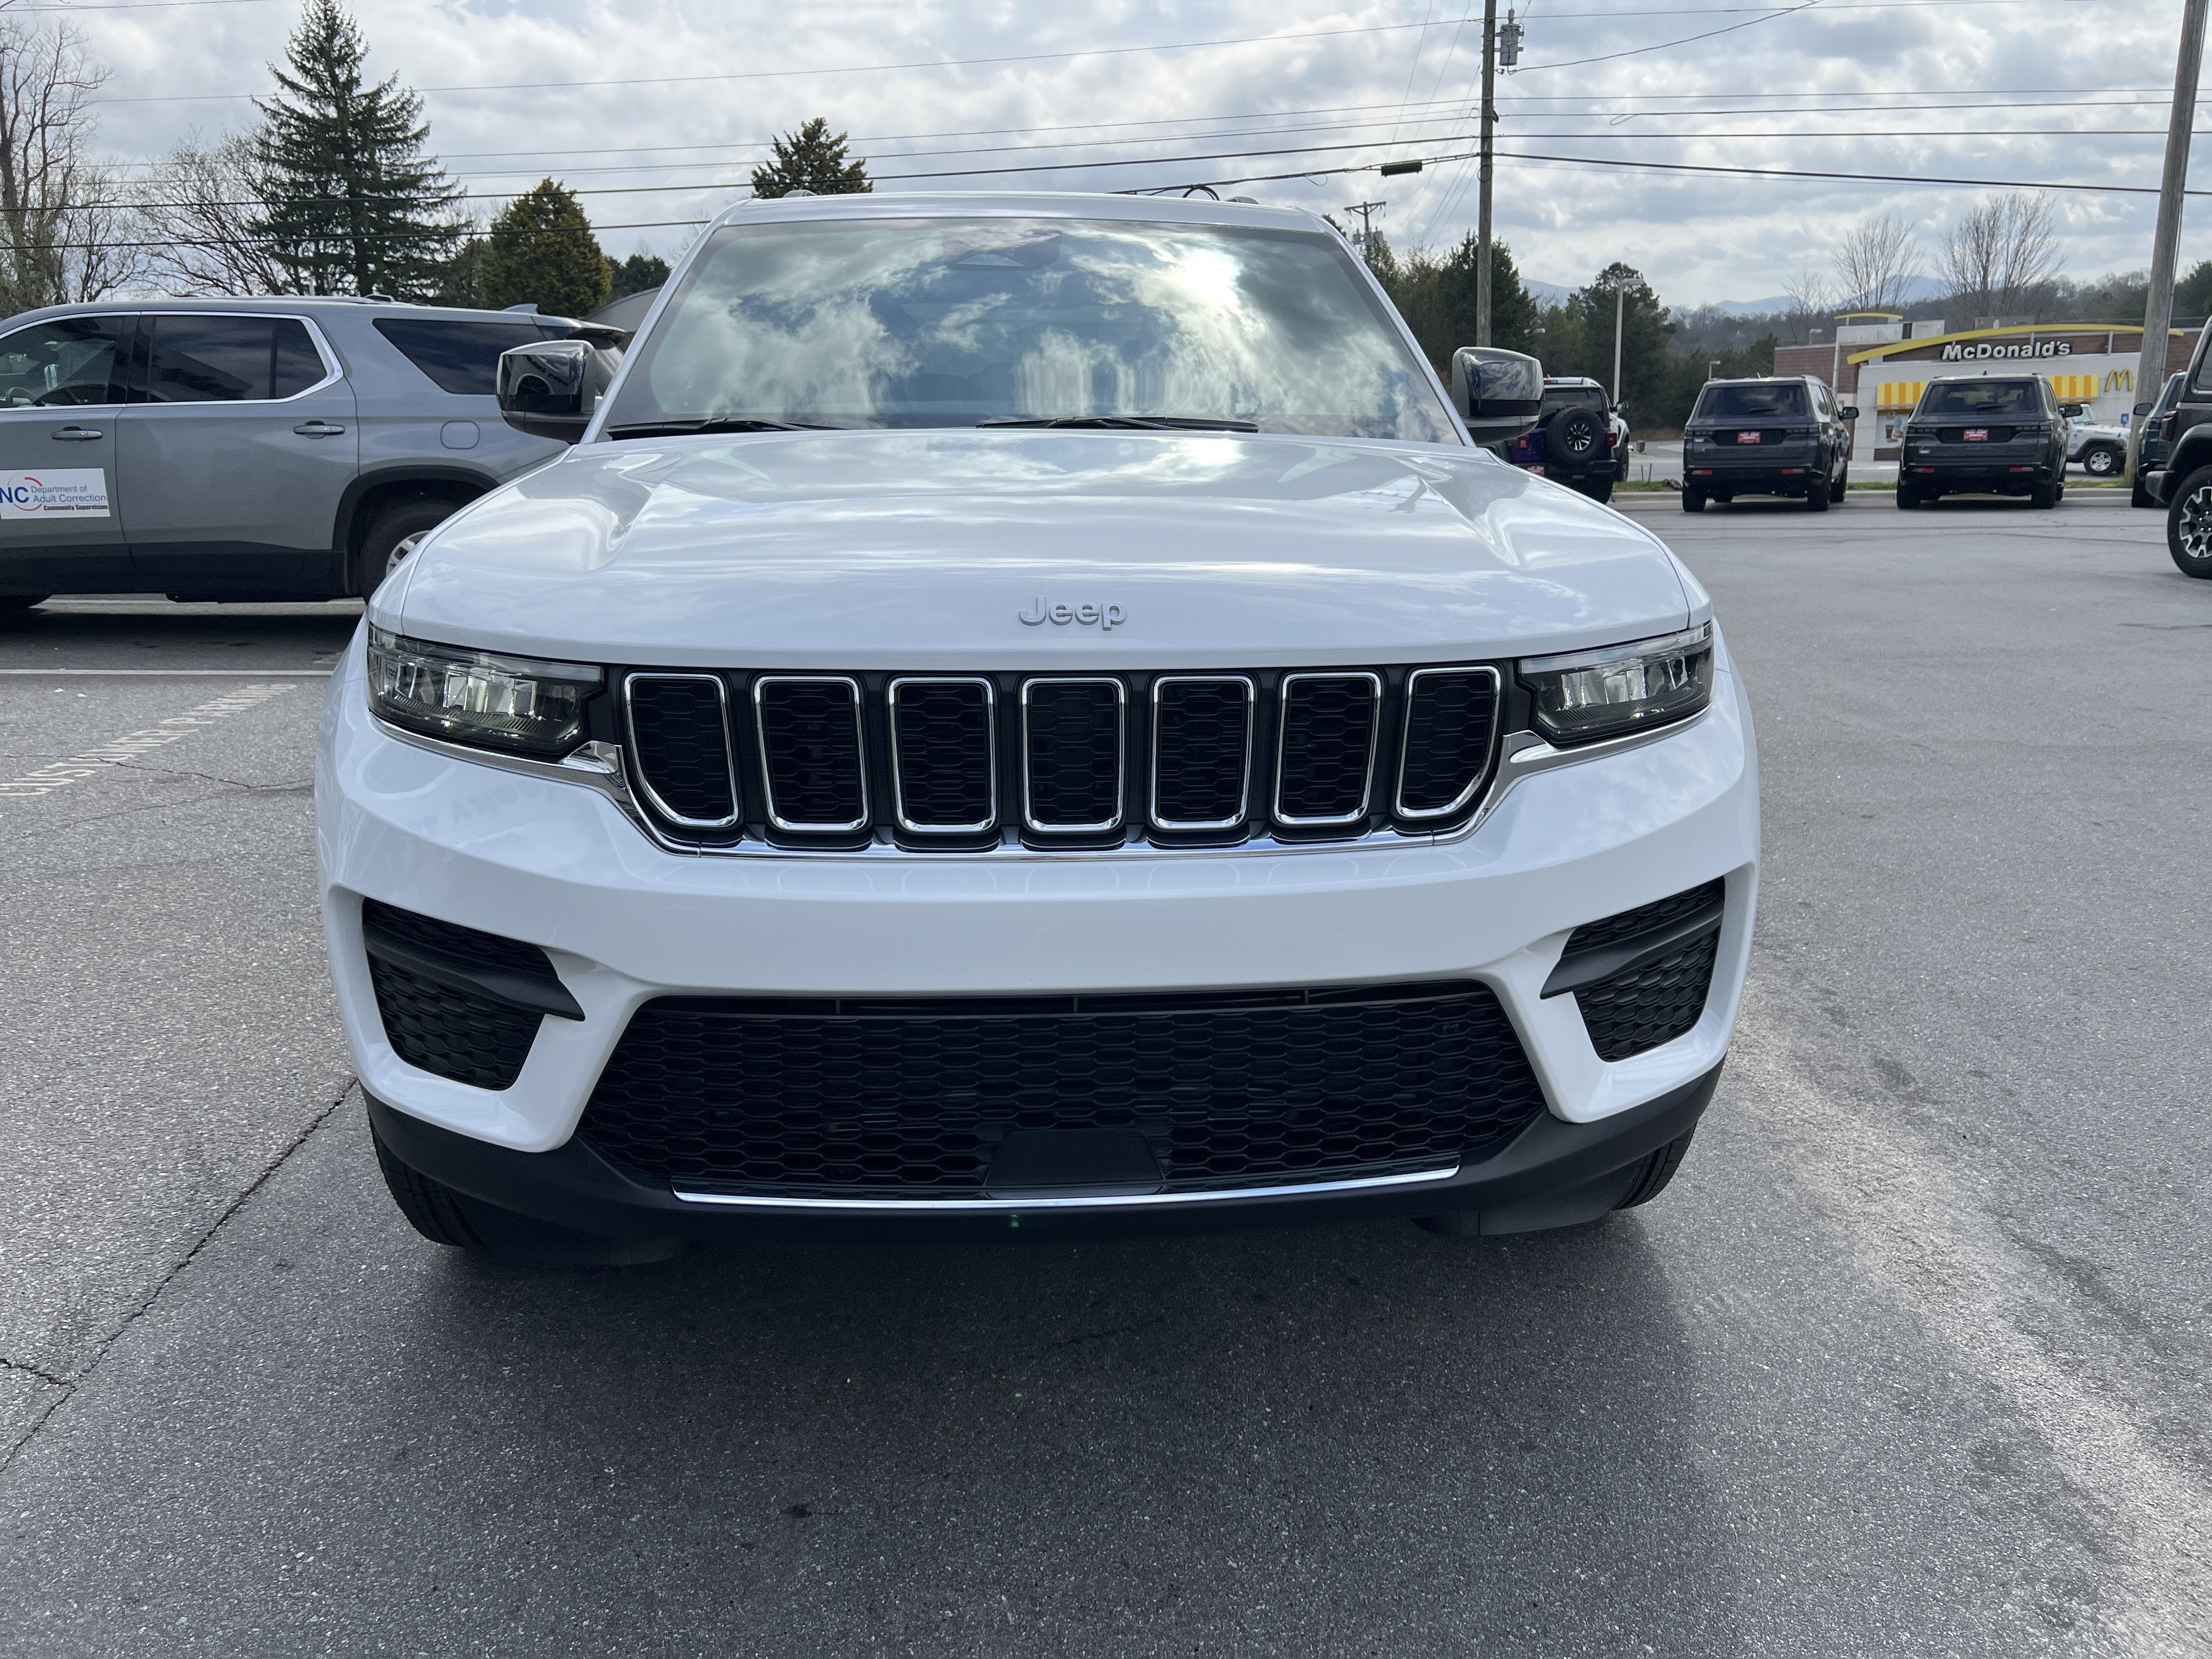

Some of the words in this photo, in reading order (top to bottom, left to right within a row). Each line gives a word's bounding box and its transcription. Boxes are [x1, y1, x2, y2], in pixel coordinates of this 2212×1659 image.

[1942, 341, 2071, 360] McDonald's
[0, 487, 29, 503] NC
[31, 486, 77, 494] Department
[33, 495, 56, 503] Adult
[59, 494, 106, 503] Correction
[1018, 595, 1127, 630] Jeep
